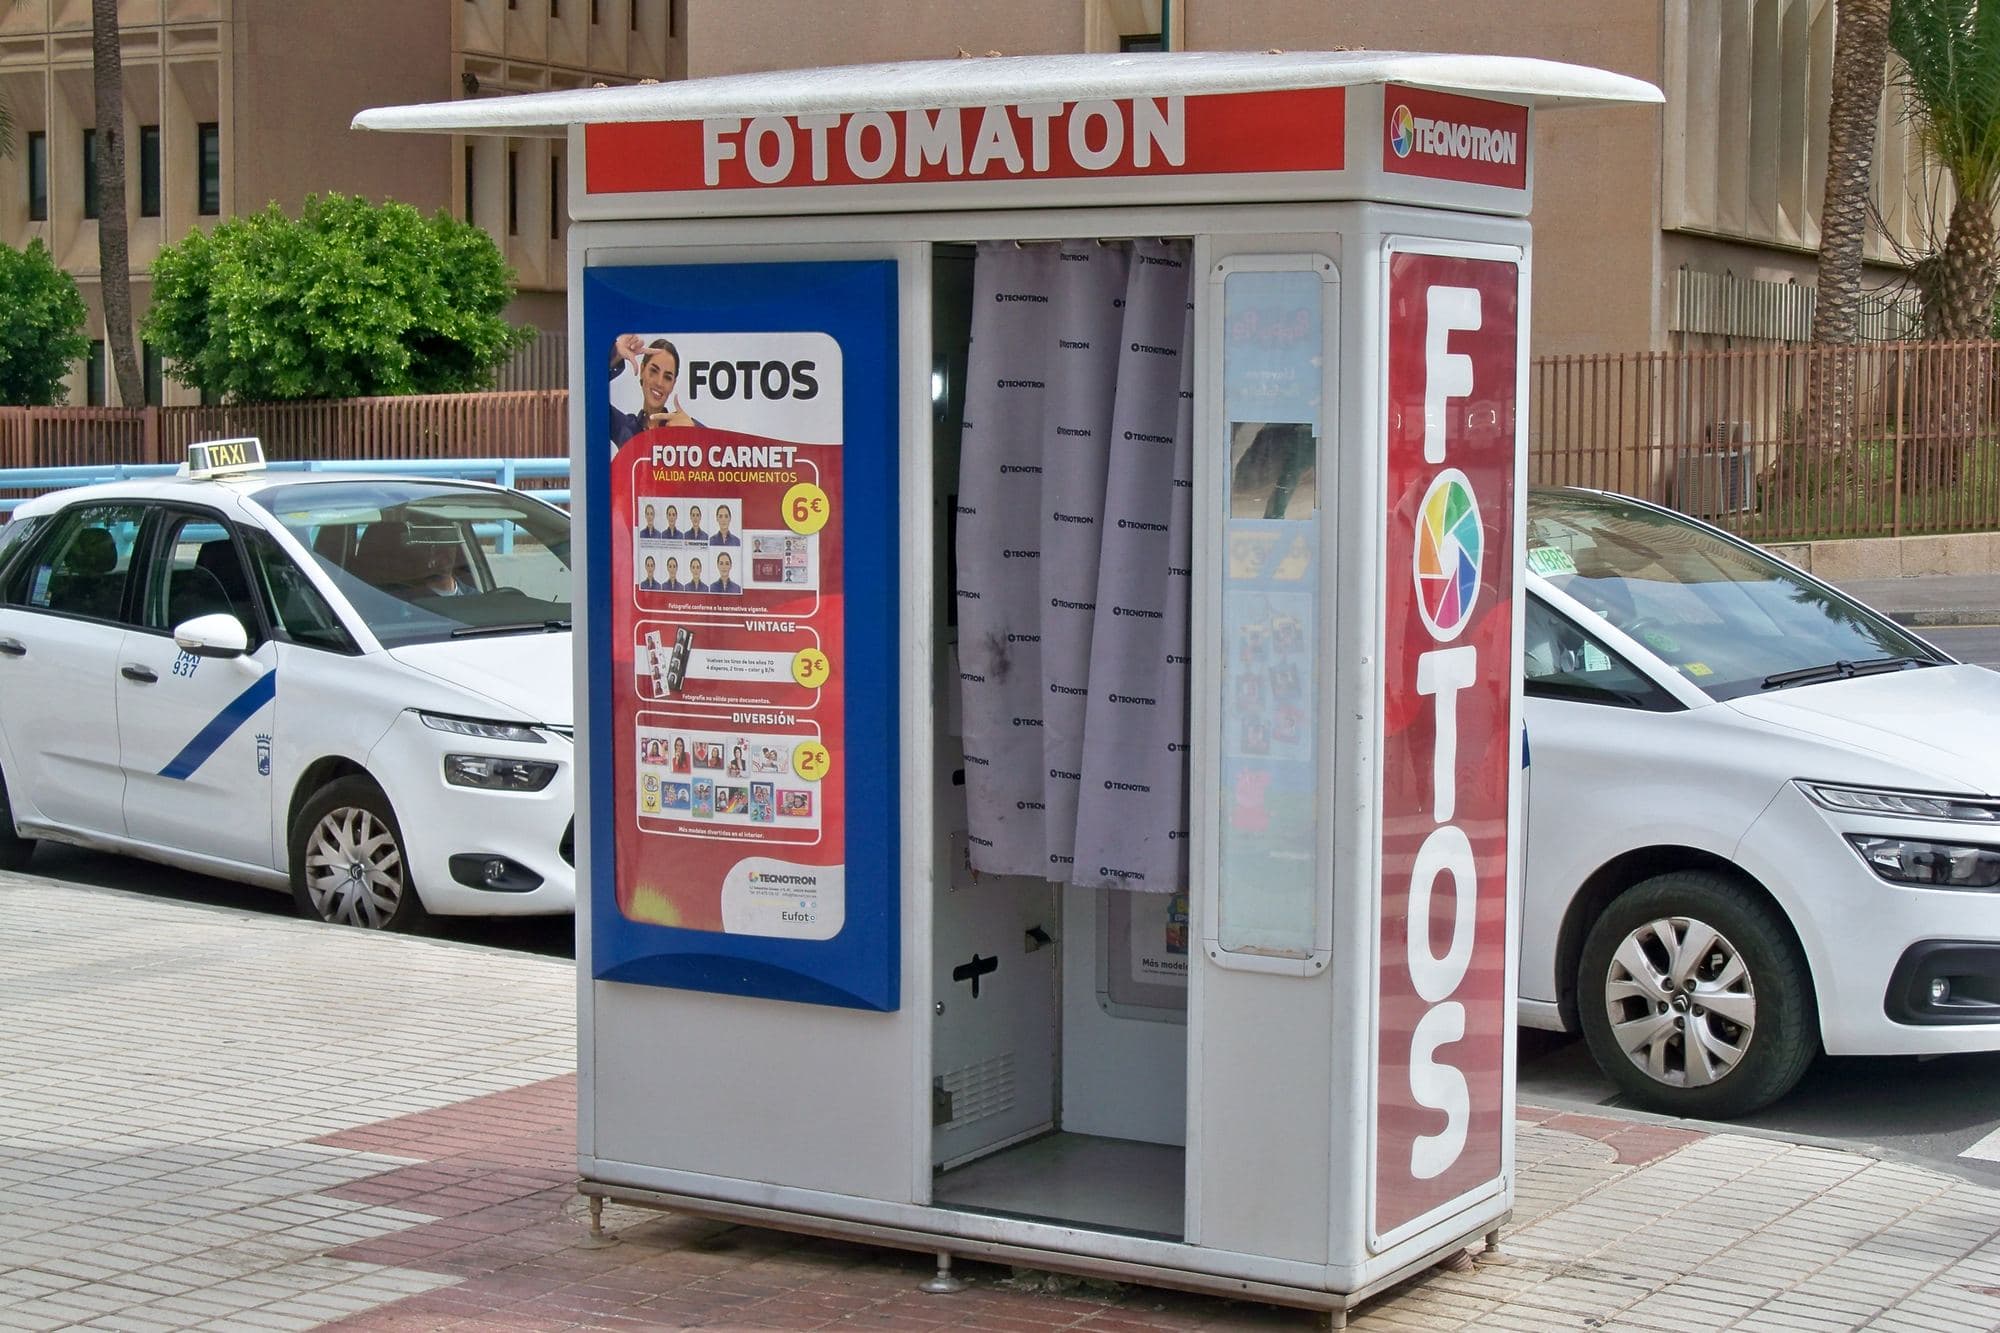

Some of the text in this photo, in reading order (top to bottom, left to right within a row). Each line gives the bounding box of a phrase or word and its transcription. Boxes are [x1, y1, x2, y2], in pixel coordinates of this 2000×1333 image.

[702, 95, 1185, 186] FOTOMATON
[1413, 117, 1517, 165] TECNOTRON
[1005, 294, 1049, 303] TECNOTRON
[688, 360, 819, 400] FOTOS
[209, 443, 246, 467] TAXI
[652, 445, 797, 468] FOTO CARNET
[653, 467, 798, 483] VÁLIDA PARA DOCUMENTOS
[792, 496, 822, 523] 6€
[1127, 521, 1168, 533] TECNOTRON
[1529, 549, 1572, 573] LIBRE
[745, 620, 796, 633] VINTAGE
[173, 661, 197, 678] 937
[800, 657, 823, 678] 3€
[732, 711, 796, 726] DIVERSIÓN
[801, 751, 825, 771] 2€
[759, 873, 817, 886] TECNOTRON
[1142, 958, 1159, 968] Más
